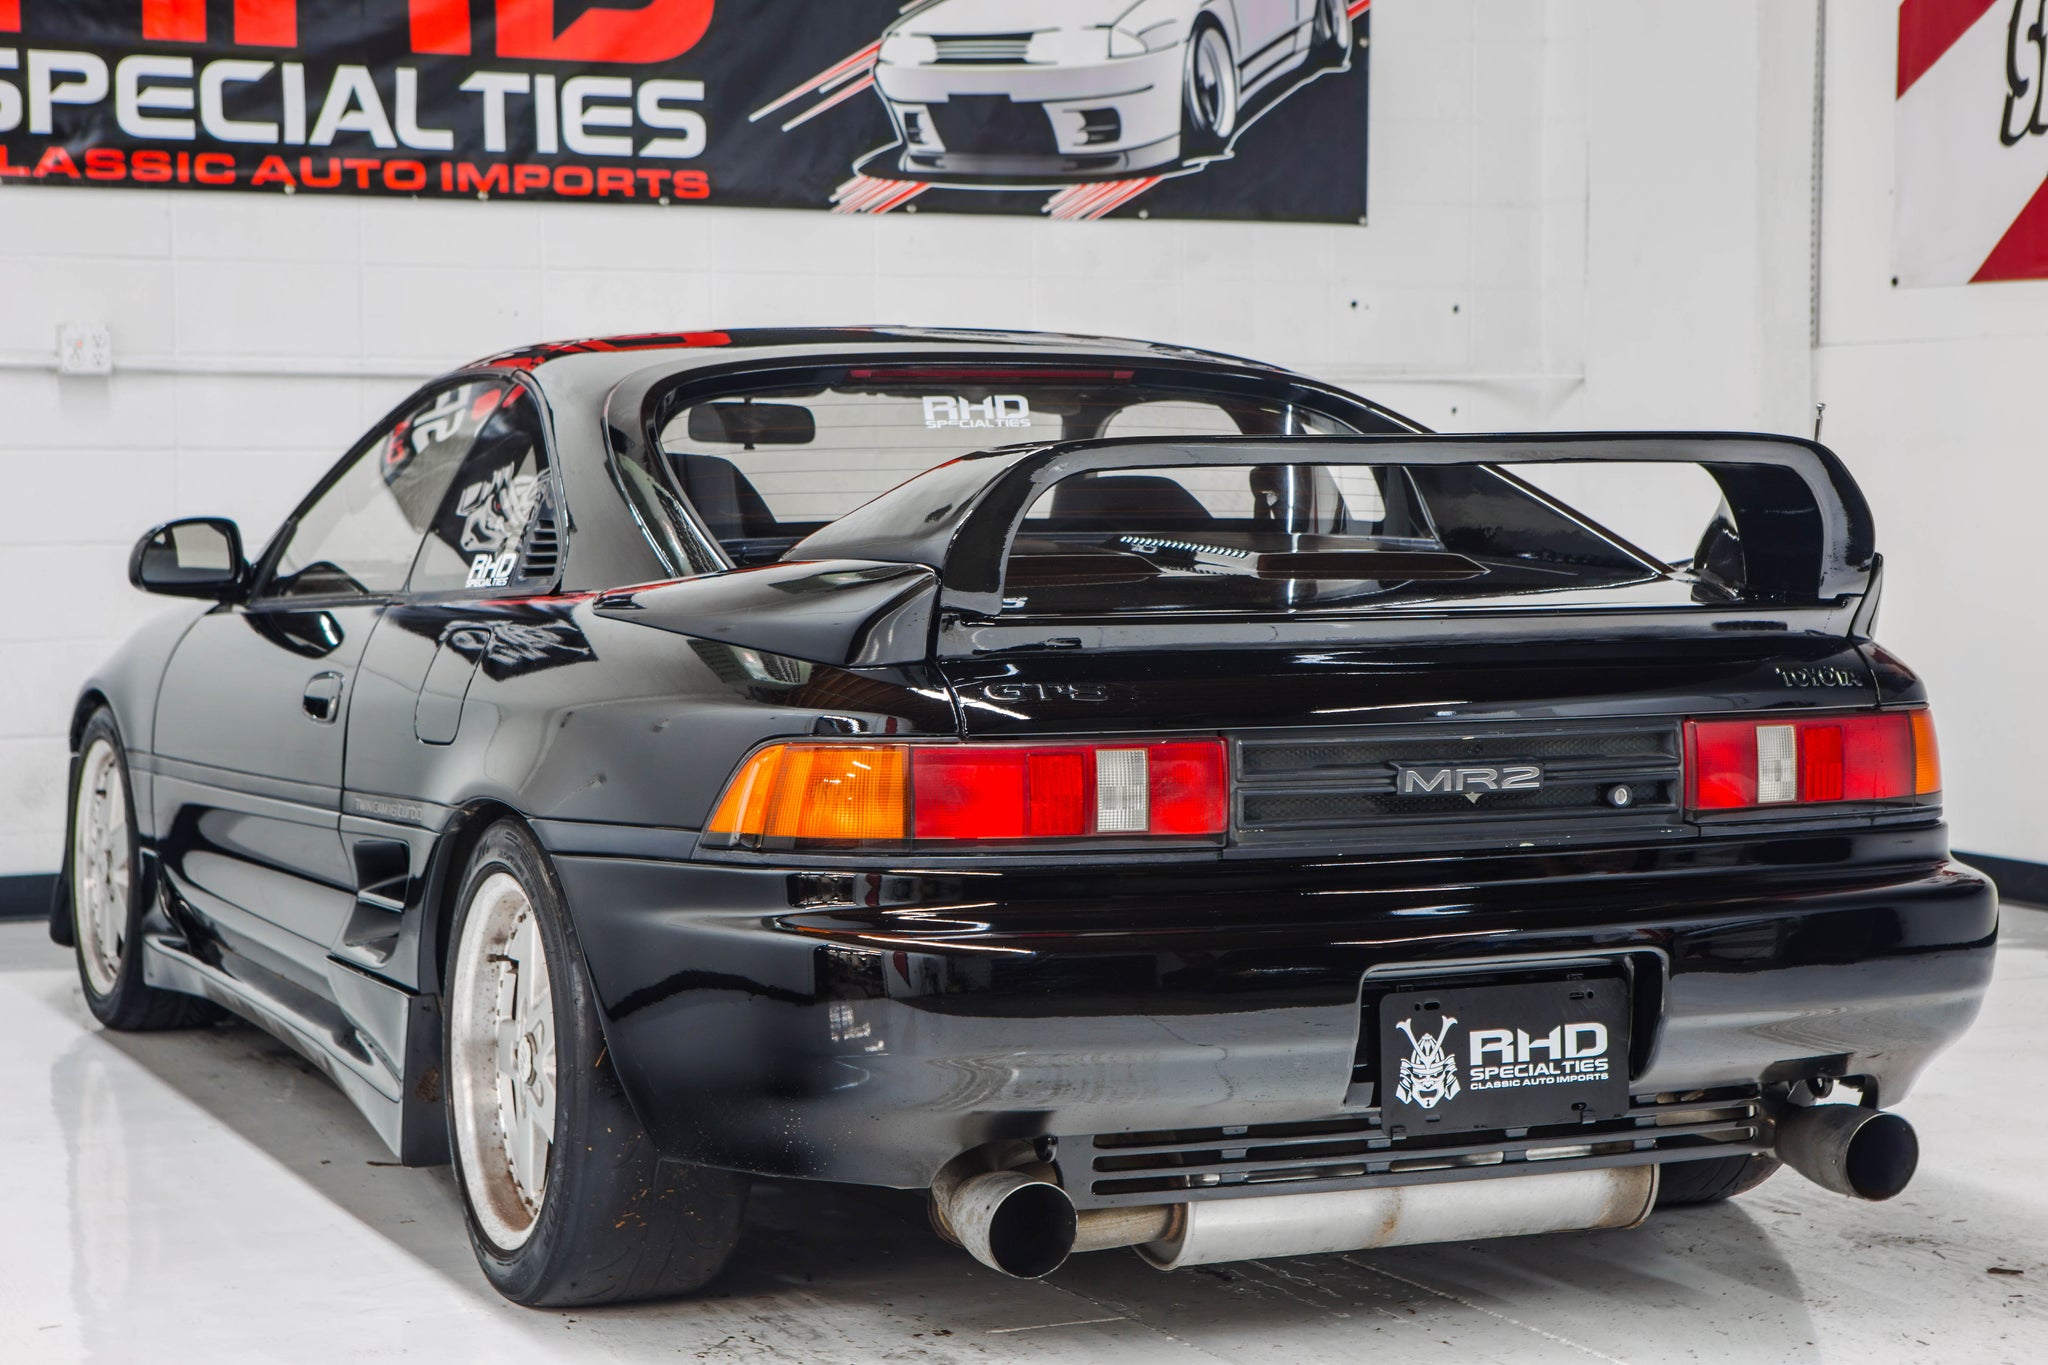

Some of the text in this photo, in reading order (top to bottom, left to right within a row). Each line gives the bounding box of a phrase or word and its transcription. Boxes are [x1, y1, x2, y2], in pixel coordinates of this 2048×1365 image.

[251, 154, 427, 190] AUTO
[441, 161, 711, 199] IMPORTS
[922, 394, 1030, 421] RHD
[925, 418, 1032, 429] SPECIALTIES
[467, 553, 517, 579] RHD
[1405, 766, 1540, 793] MR2
[1469, 1023, 1608, 1066] RHD
[1470, 1058, 1609, 1081] SPECIALTIES
[1470, 1072, 1609, 1090] CLASSIC AUTO IMPORTS
